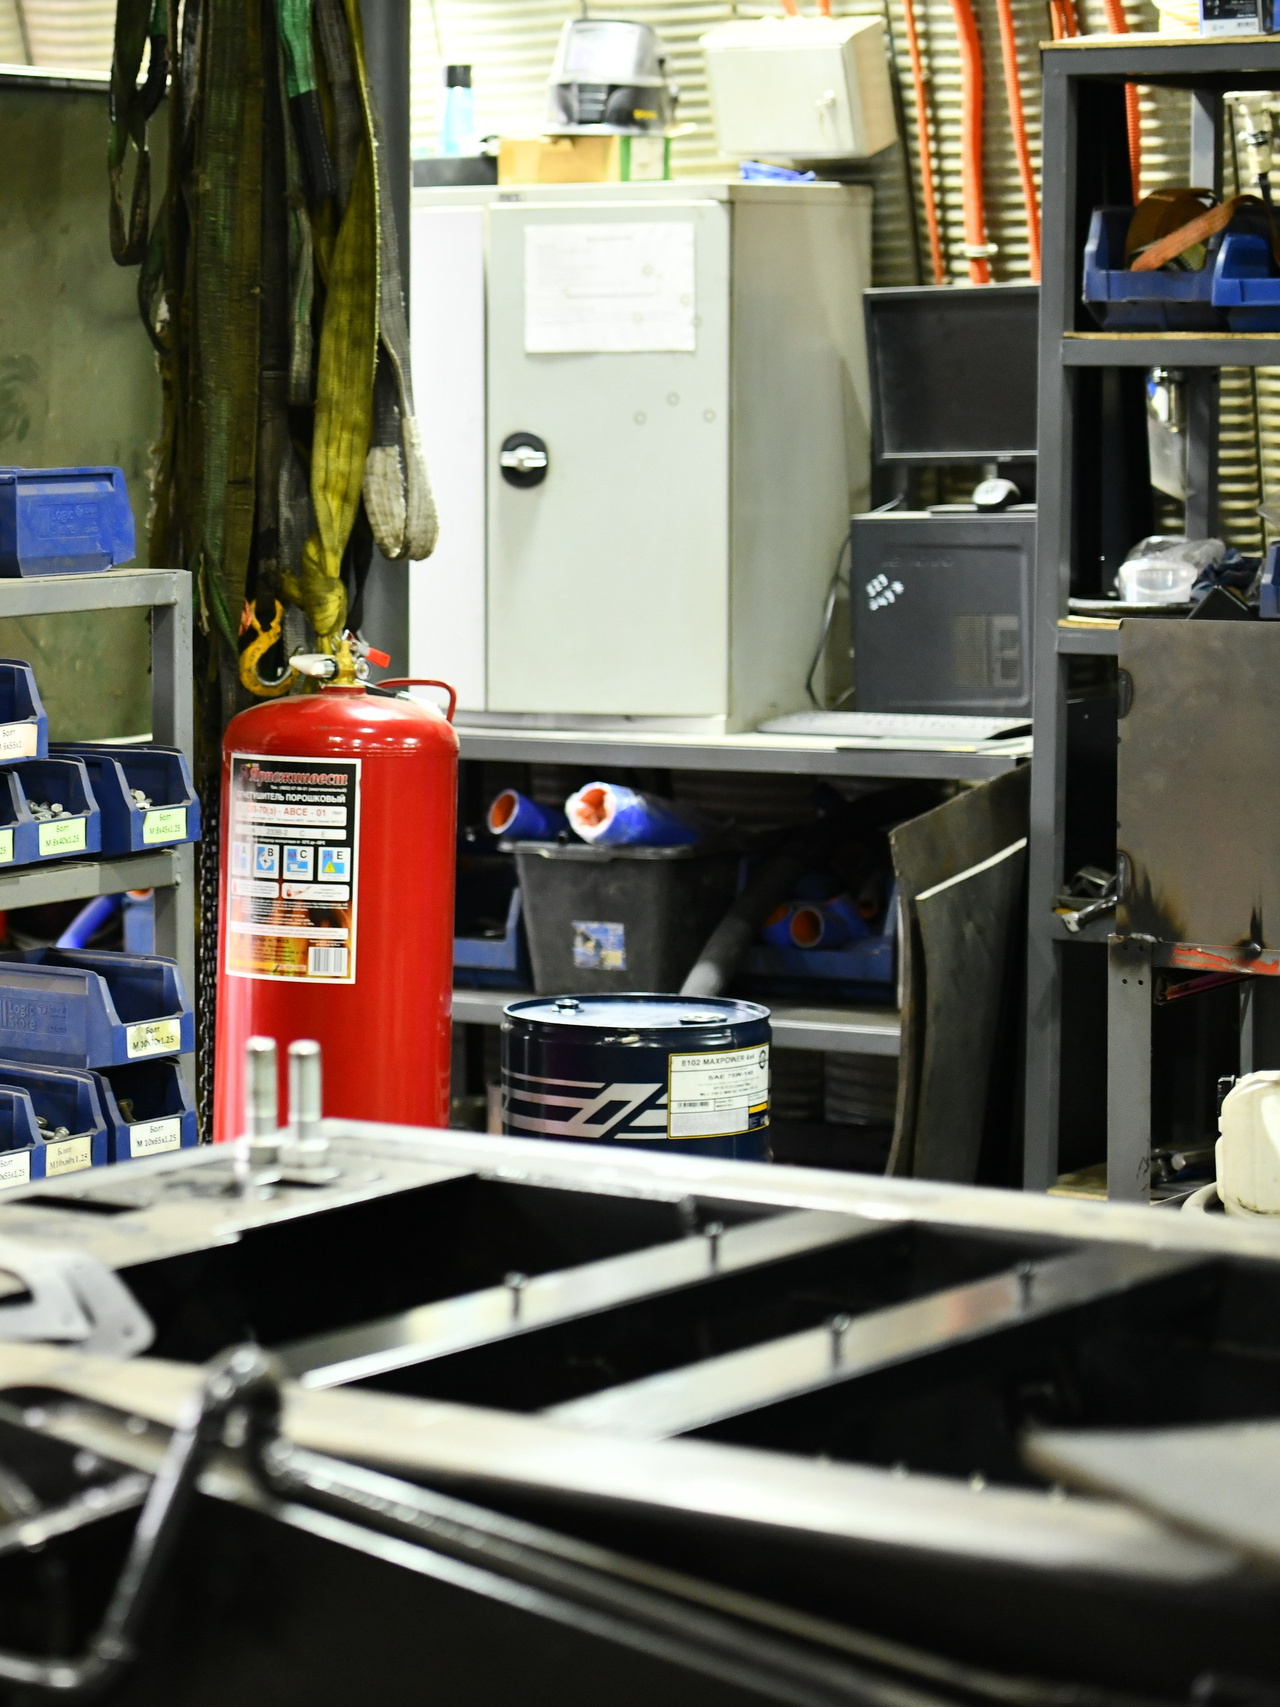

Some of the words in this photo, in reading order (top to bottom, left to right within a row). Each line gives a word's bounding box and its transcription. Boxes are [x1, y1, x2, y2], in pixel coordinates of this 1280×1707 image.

[2, 729, 15, 737] Болт
[286, 793, 345, 804] ПОРОШКОВЫЙ
[159, 813, 172, 821] Болт
[316, 809, 326, 818] 01
[56, 824, 69, 833] Болт
[267, 847, 274, 857] B
[299, 849, 308, 859] C
[336, 851, 344, 860] E
[145, 1026, 160, 1035] Болт
[702, 1054, 745, 1065] MAXPOWER
[149, 1125, 164, 1134] Болт
[0, 1159, 13, 1168] Болт
